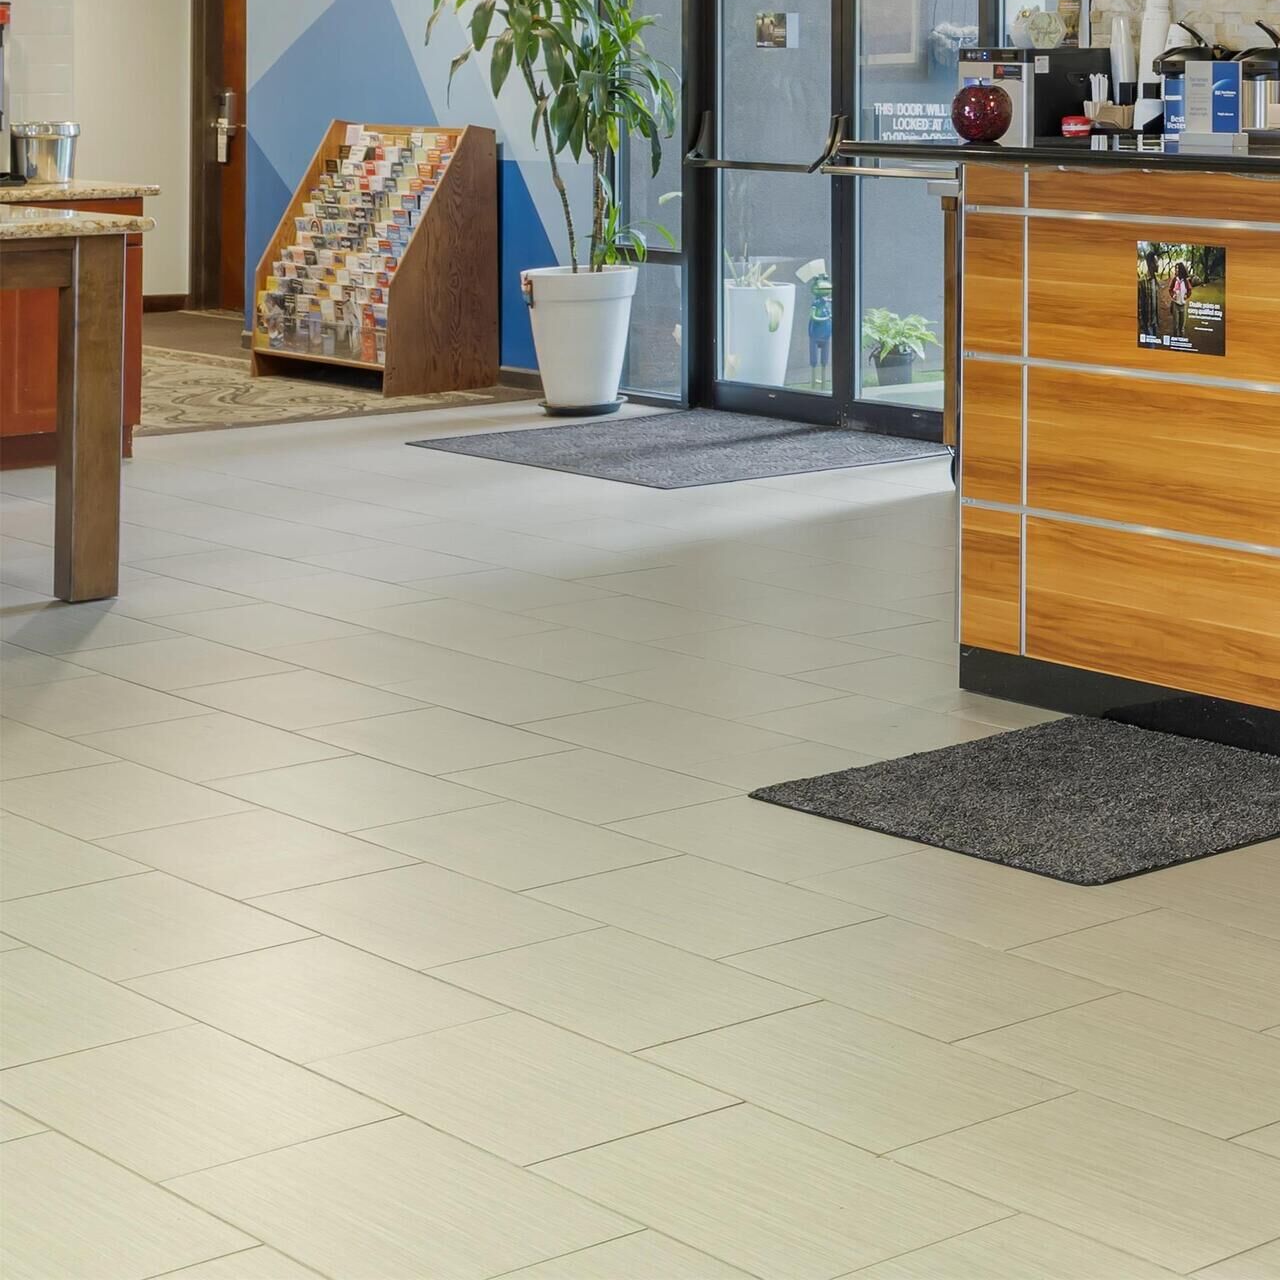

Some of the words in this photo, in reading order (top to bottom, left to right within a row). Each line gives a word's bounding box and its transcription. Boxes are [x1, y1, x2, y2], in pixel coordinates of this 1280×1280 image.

[874, 103, 893, 115] THIS
[897, 103, 922, 115] DOOR
[926, 104, 947, 116] WILL
[893, 118, 928, 130] LOCKED
